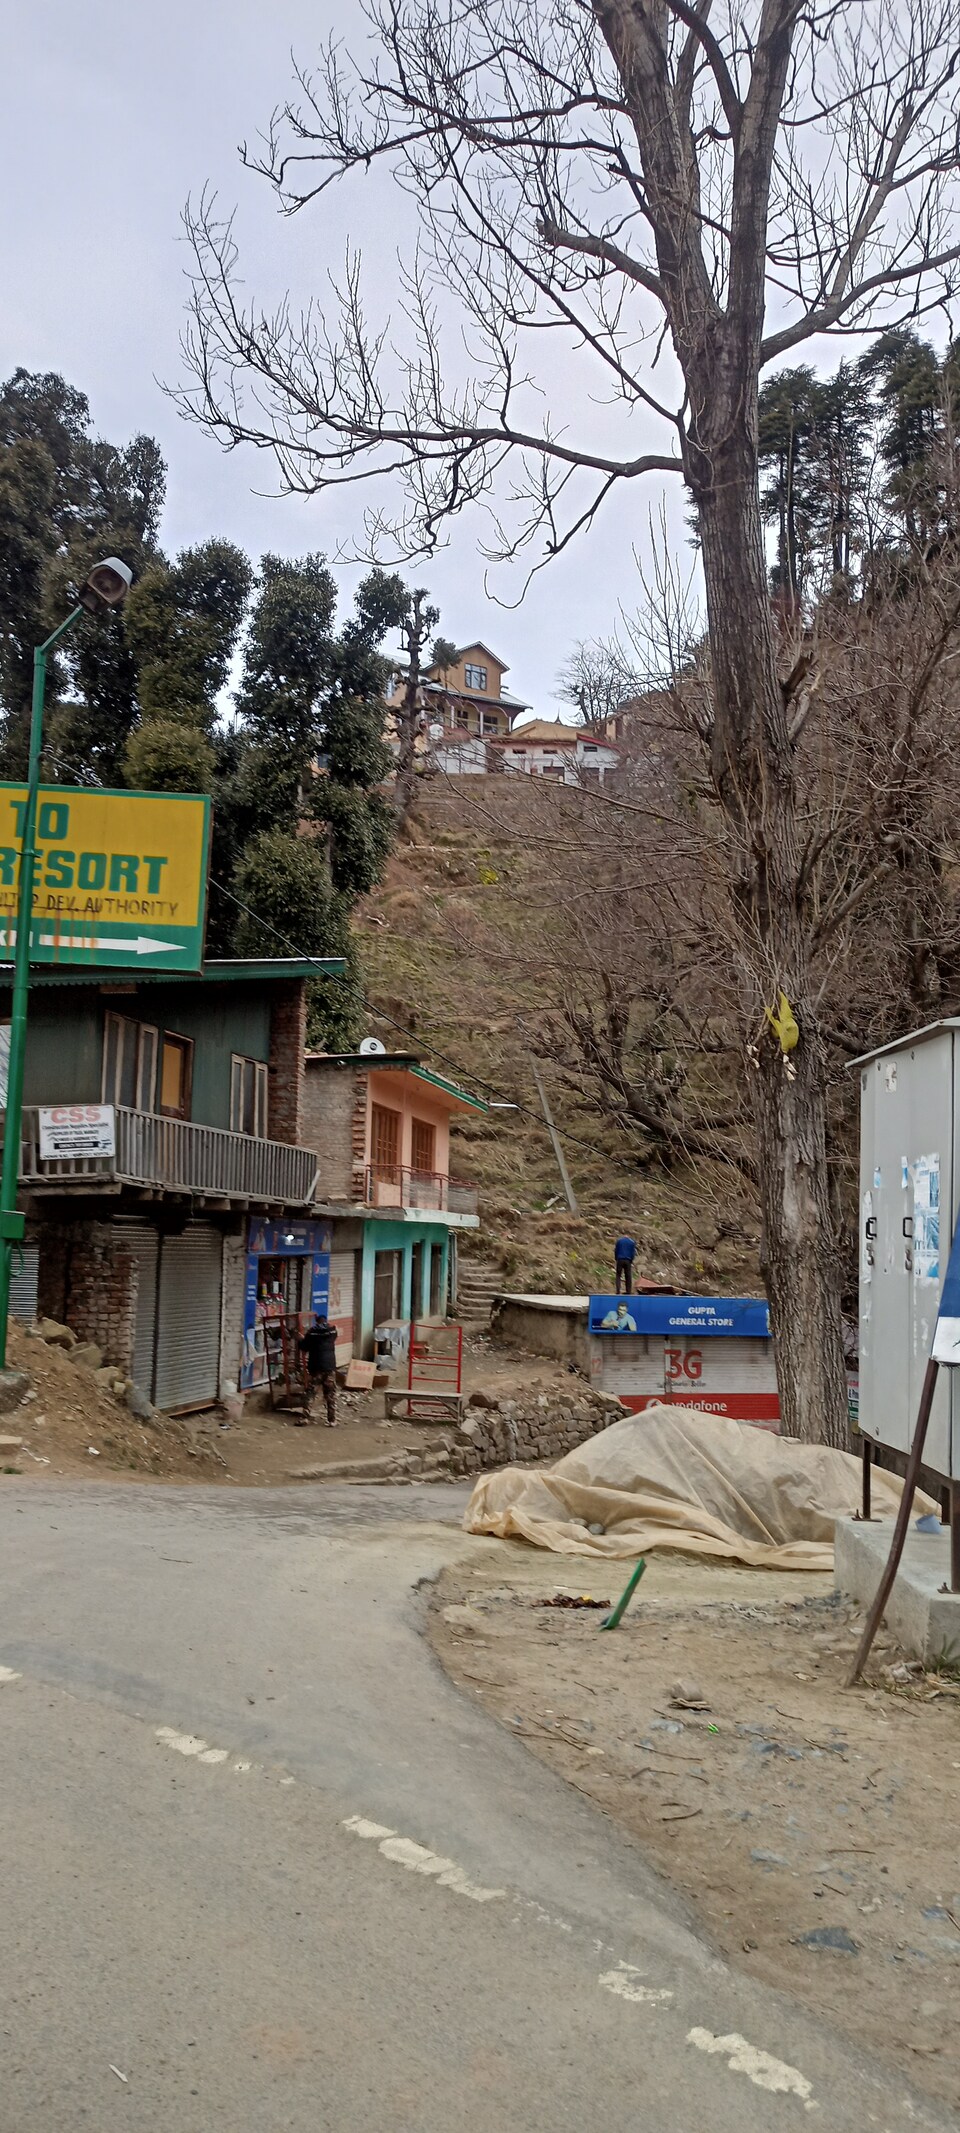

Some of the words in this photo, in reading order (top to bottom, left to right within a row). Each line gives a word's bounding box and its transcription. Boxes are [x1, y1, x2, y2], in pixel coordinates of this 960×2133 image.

[9, 800, 70, 840] TO
[84, 896, 179, 917] AUTHORITY
[52, 1107, 101, 1123] CSS
[687, 1306, 716, 1316] GUPTA
[669, 1317, 707, 1327] GENERAL
[707, 1318, 734, 1328] STORE
[664, 1349, 702, 1379] 3G
